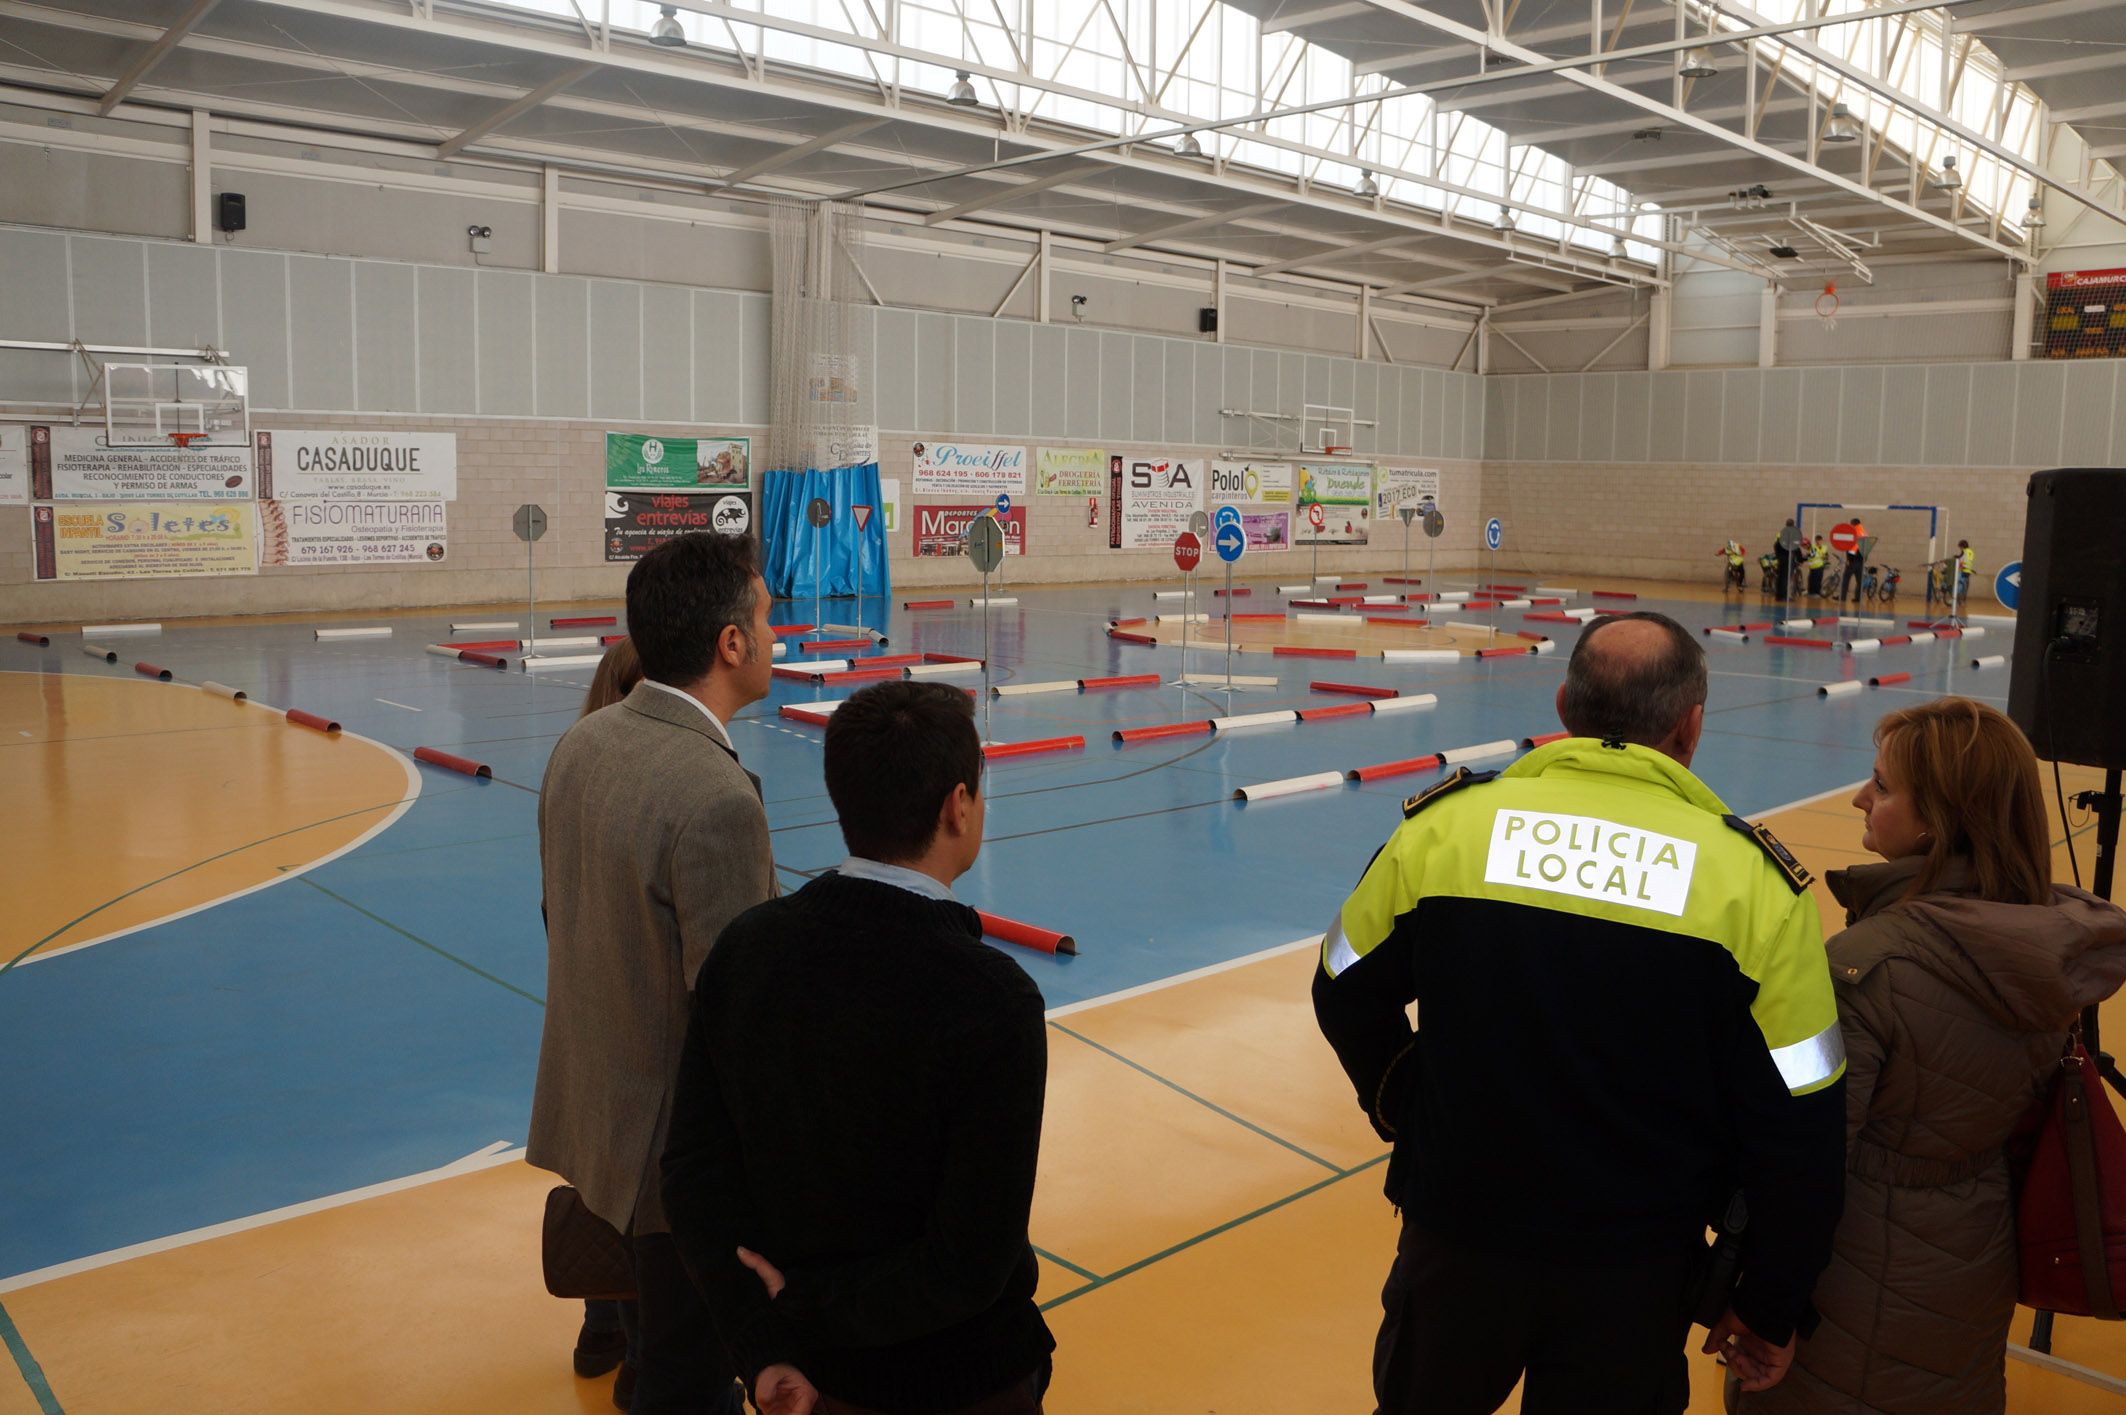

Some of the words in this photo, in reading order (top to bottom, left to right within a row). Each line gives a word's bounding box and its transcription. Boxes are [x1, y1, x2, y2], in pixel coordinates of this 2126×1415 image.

[331, 436, 390, 445] ASADOR
[64, 455, 105, 463] MEDICINA
[107, 455, 143, 463] GENERAL
[150, 455, 196, 463] ACCIDENTES
[297, 446, 421, 472] CASADUQUE
[57, 463, 110, 471] FISIOTERAPIA
[118, 463, 181, 472] REHABILITACIÓN
[187, 464, 248, 472] ESPECIALIDADES
[83, 473, 155, 481] RECONOCIMIENTO
[169, 473, 225, 481] CONDUCTORES
[936, 470, 951, 478] 624
[121, 482, 155, 490] PERMISO
[157, 482, 168, 490] DE
[170, 482, 198, 490] ARMAS
[320, 490, 331, 498] del
[1211, 491, 1248, 500] carpinteros
[1382, 488, 1401, 505] 2017
[1402, 486, 1417, 500] ECO
[651, 494, 689, 511] viajes
[1131, 501, 1193, 509] AVENIDA
[58, 514, 105, 526] ESCUELA
[293, 505, 443, 525] FISIOMATURANA
[636, 509, 708, 526] entrevías
[60, 527, 104, 539] INFANTIL
[401, 525, 444, 533] Fisioterapia
[301, 545, 317, 554] 679
[319, 545, 334, 554] 167
[336, 545, 354, 554] 926
[362, 545, 379, 553] 968
[381, 545, 397, 553] 627
[399, 544, 416, 553] 245
[1175, 546, 1199, 558] STOP
[1504, 815, 1680, 871] POLICIA
[1516, 849, 1651, 901] LOCAL
